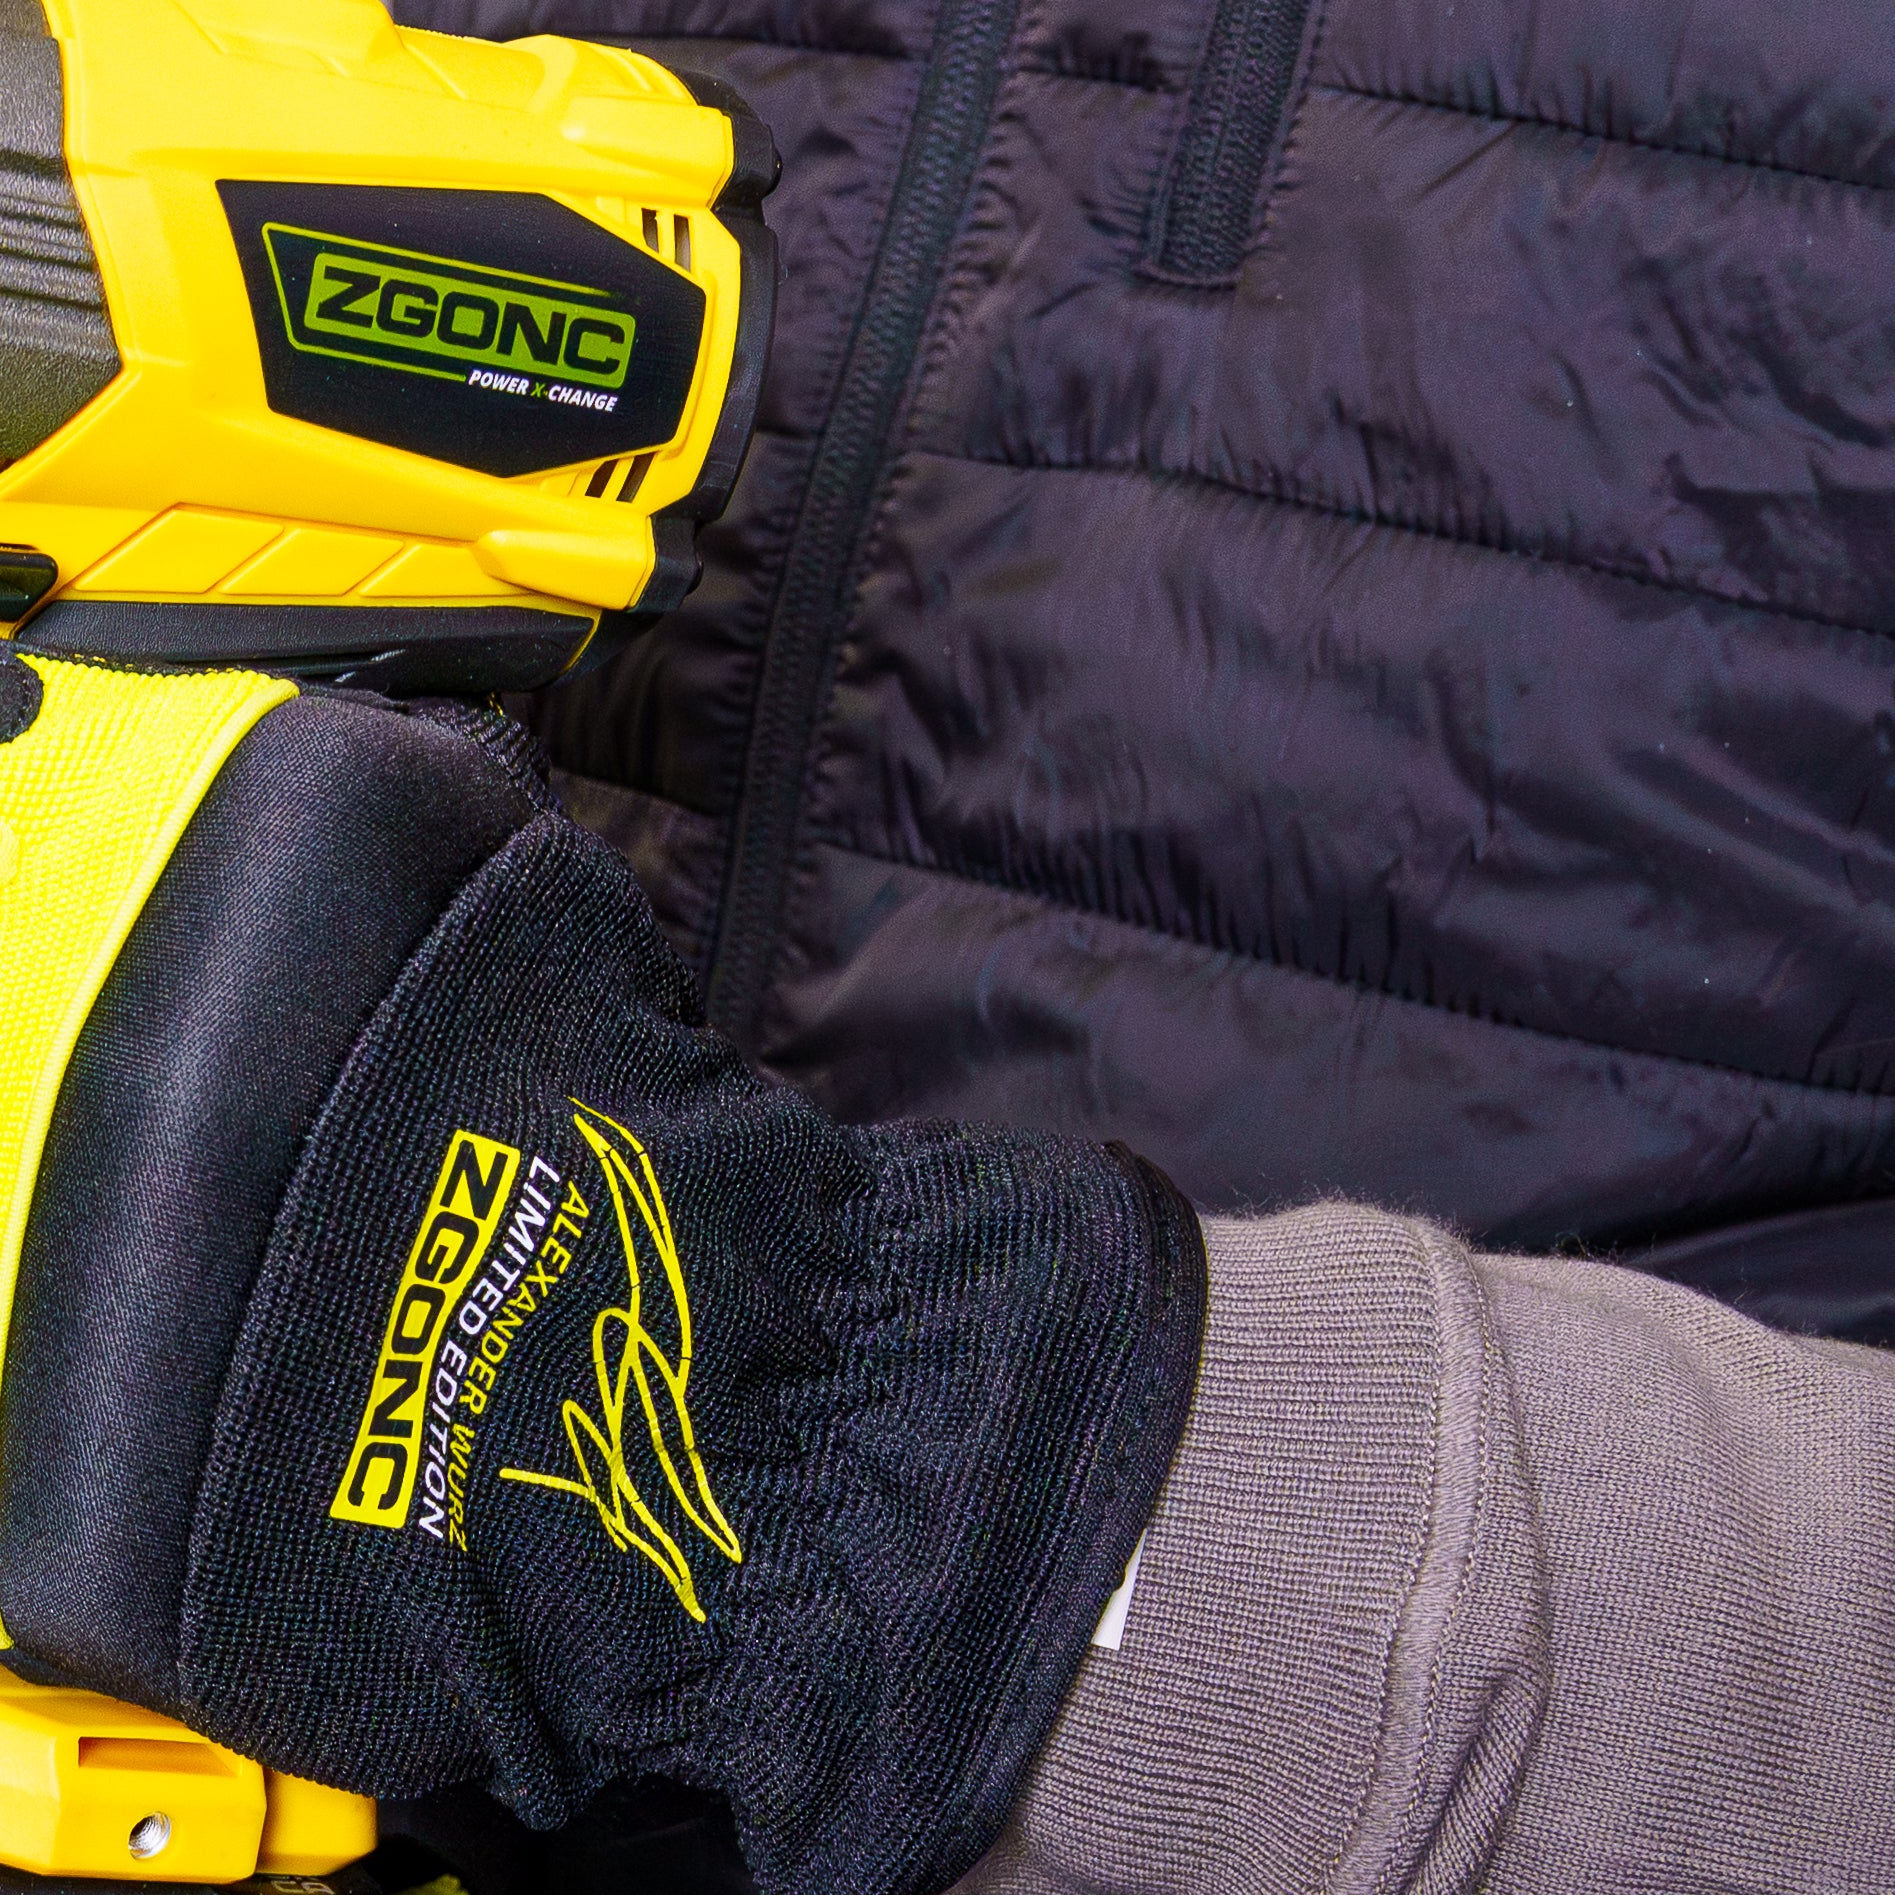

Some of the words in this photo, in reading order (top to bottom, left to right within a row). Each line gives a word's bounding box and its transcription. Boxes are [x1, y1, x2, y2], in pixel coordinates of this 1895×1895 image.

[315, 264, 627, 376] ZGONC
[468, 368, 529, 397] POWER
[531, 380, 619, 413] X-CHANGE
[346, 1137, 510, 1511] ZGONC
[457, 1156, 561, 1336] LIMITED
[457, 1180, 592, 1416] ALEXANDER
[418, 1340, 467, 1539] EDITION
[446, 1421, 478, 1553] WURZ
